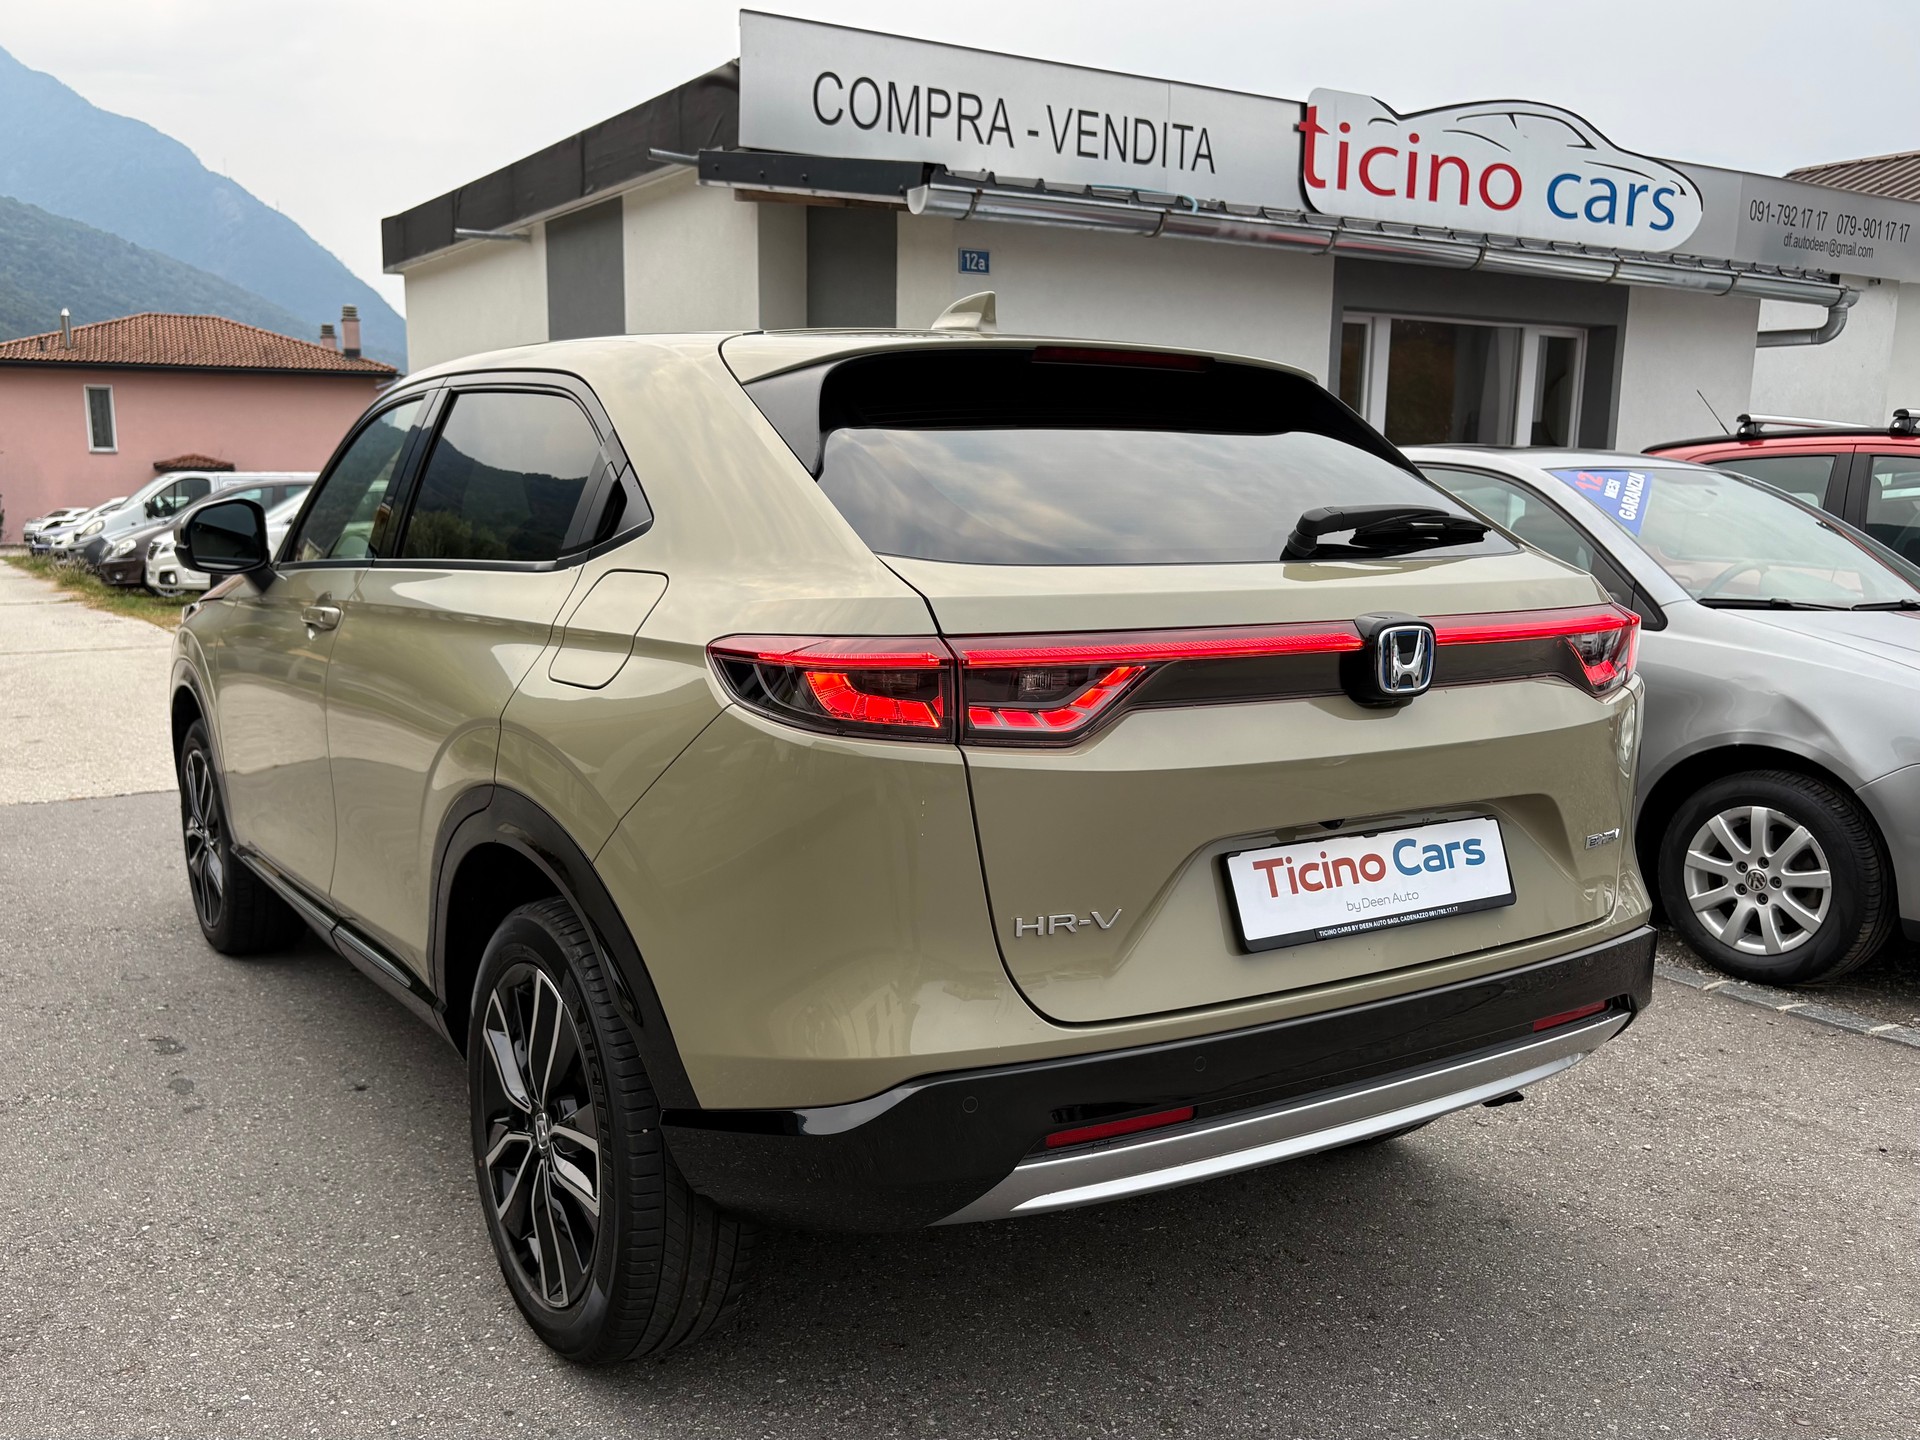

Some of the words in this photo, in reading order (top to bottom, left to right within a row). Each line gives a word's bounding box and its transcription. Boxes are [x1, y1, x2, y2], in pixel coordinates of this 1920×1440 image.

[812, 71, 1015, 149] COMPRA
[1298, 105, 1523, 212] ticino
[1546, 172, 1676, 232] cars
[1749, 199, 1798, 227] 091-792
[1801, 208, 1813, 230] 17
[1816, 211, 1828, 232] 17
[1885, 221, 1897, 242] 17
[1900, 223, 1910, 243] 17
[1783, 232, 1874, 258] df.autodeen@gmail.com
[965, 253, 985, 270] 12a
[1574, 471, 1604, 491] 12
[1603, 478, 1621, 499] MESI
[1618, 472, 1646, 520] GARANZIA
[1252, 850, 1387, 898] Ticino
[1392, 838, 1486, 876] Cars
[1345, 900, 1361, 912] by
[1361, 895, 1391, 909] Deen
[1392, 891, 1420, 904] Auto
[1015, 908, 1122, 938] HR-V
[1319, 928, 1338, 937] TICINO
[1337, 926, 1352, 934] CARS
[1359, 922, 1373, 930] DEEN
[1373, 919, 1387, 928] AUTO
